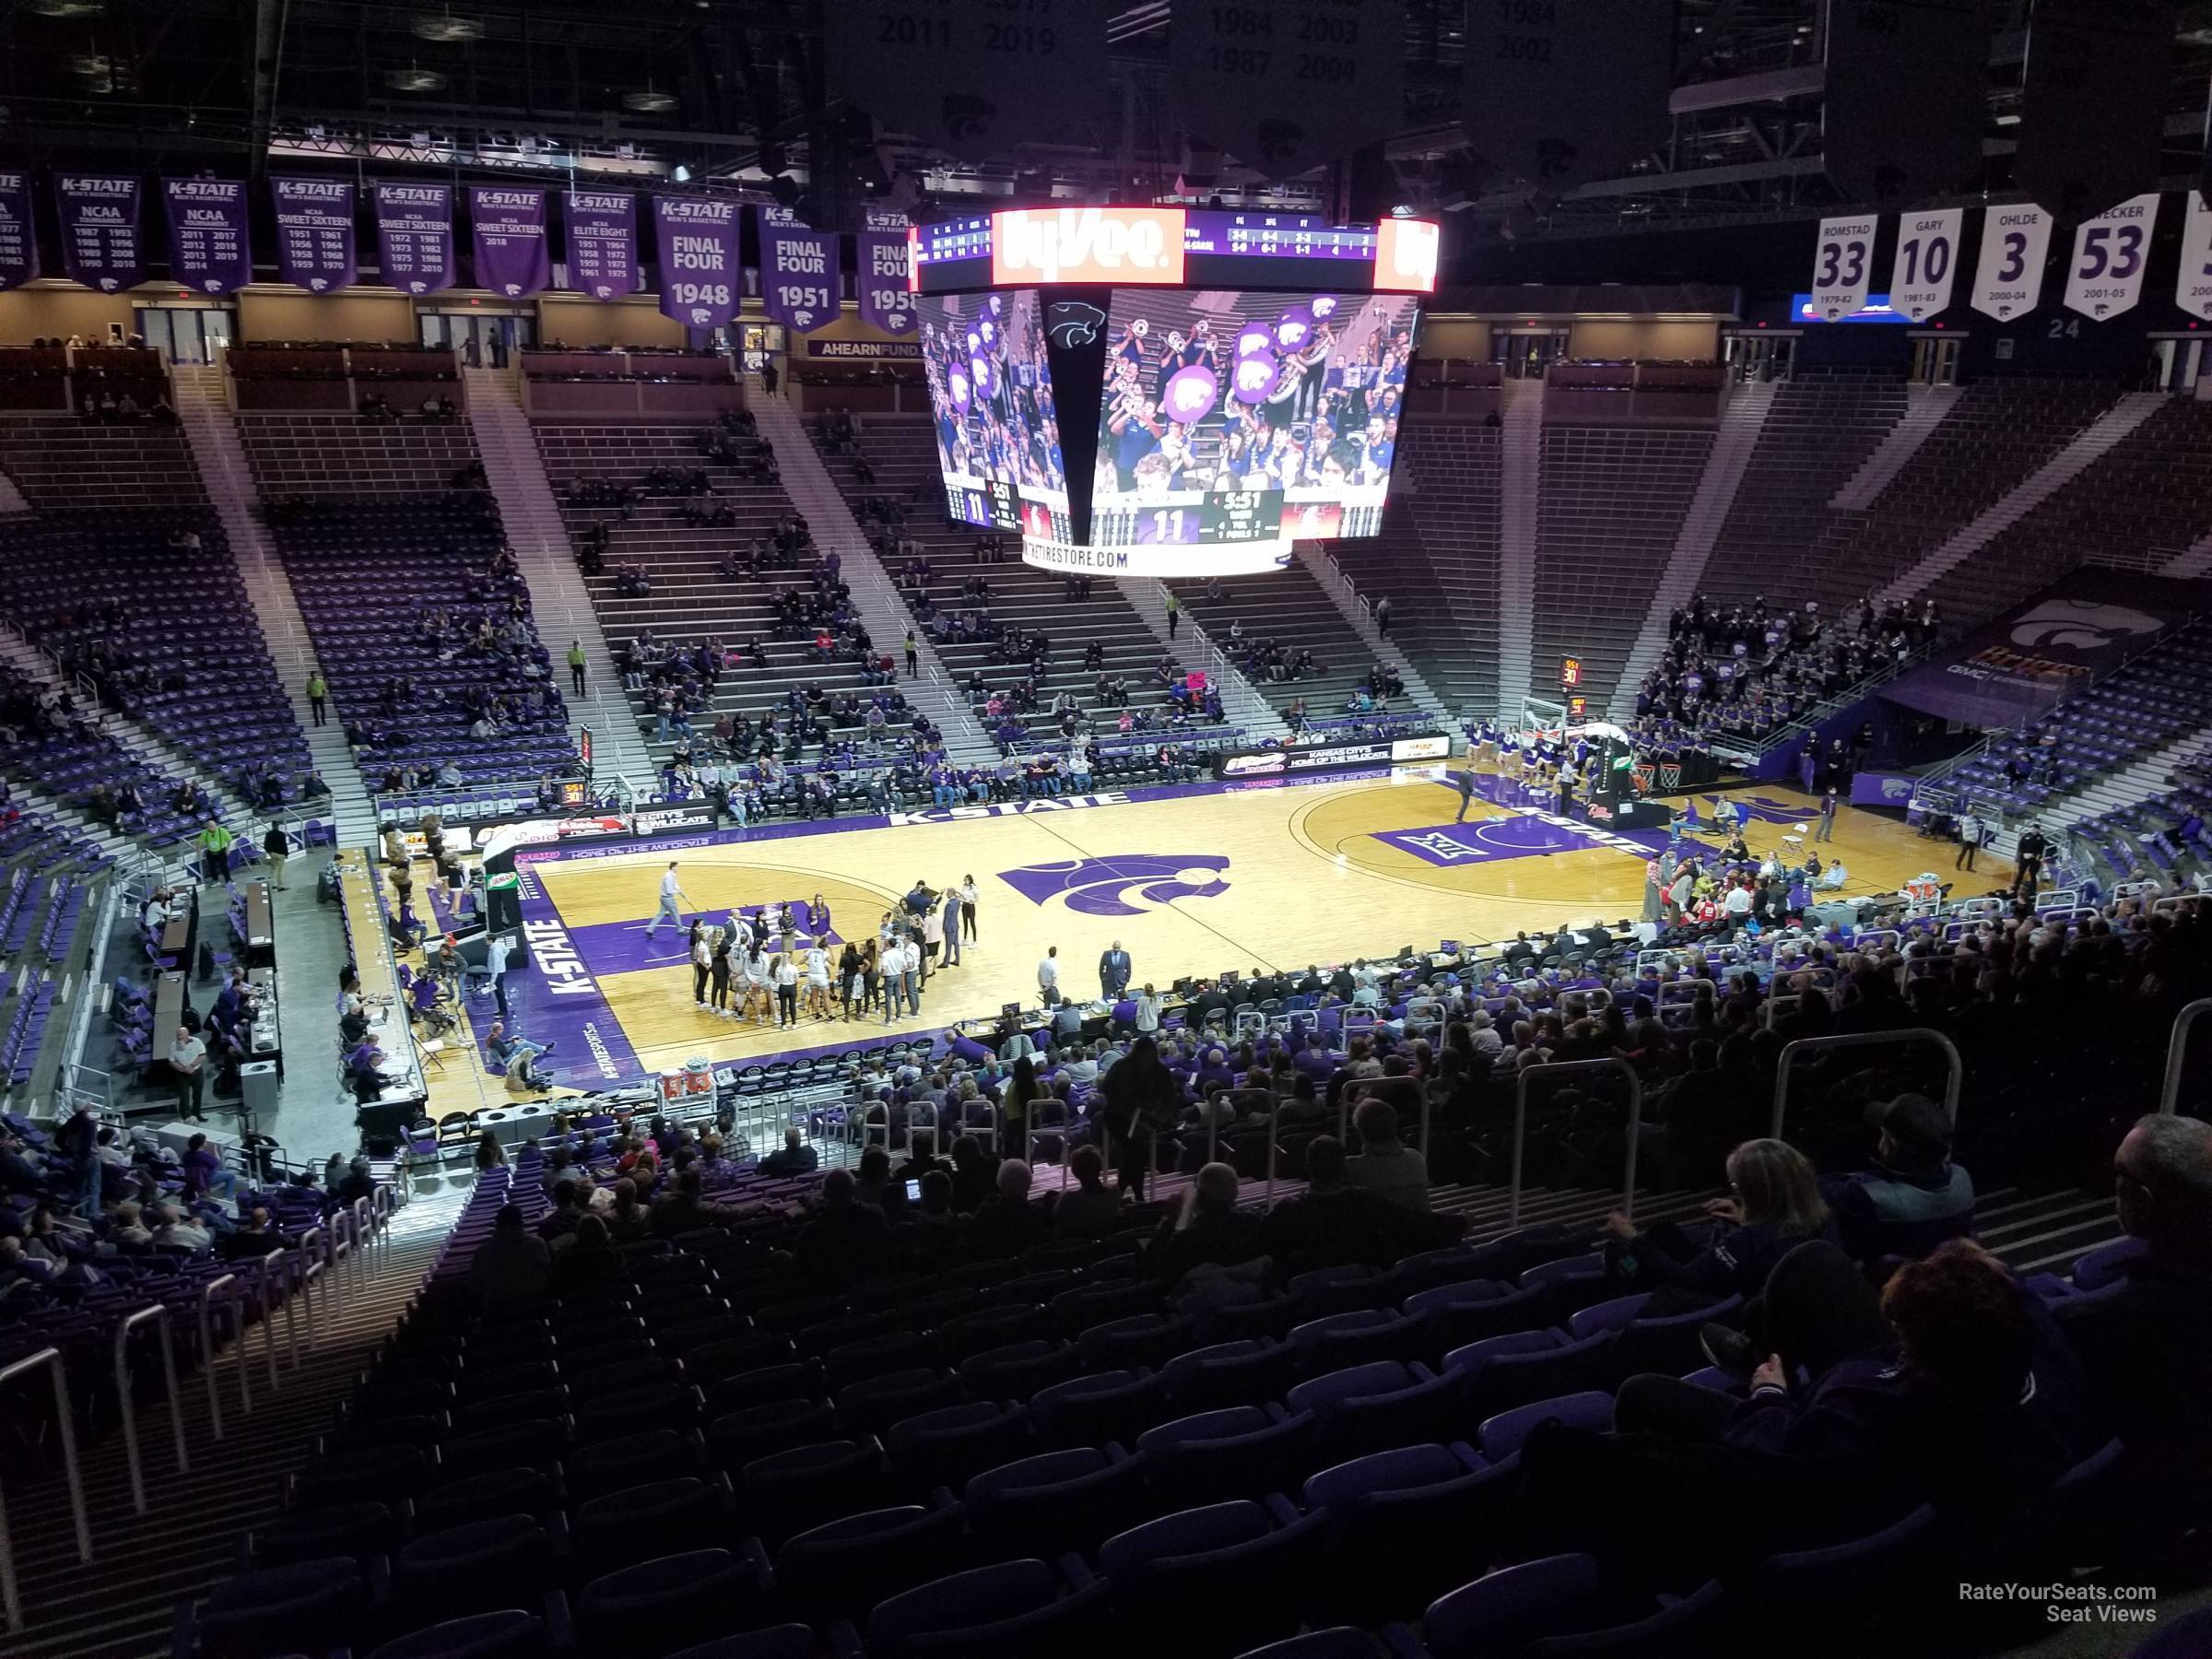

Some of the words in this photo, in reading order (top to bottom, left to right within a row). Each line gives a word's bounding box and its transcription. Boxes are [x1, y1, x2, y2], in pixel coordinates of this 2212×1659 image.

[877, 15, 950, 46] 2011
[986, 22, 1055, 54] 2019
[62, 178, 135, 192] K-STATE
[170, 182, 239, 196] K-STATE
[278, 182, 346, 196] K-STATE
[380, 187, 444, 201] K-STATE
[477, 192, 539, 206] K-STATE
[570, 196, 629, 209] K-STATE
[81, 206, 121, 218] NCAA
[186, 209, 224, 221] NCAA
[661, 202, 734, 219] K-STATE
[277, 214, 312, 225] SWEET
[312, 216, 352, 227] SIXTEEN
[379, 219, 409, 229] SWEET
[411, 219, 450, 230] SIXTEEN
[1915, 219, 1945, 231] GARY
[1999, 214, 2039, 227] OHLDE
[181, 230, 204, 239] 2011
[320, 230, 341, 240] 1961
[476, 223, 507, 232] SWEET
[507, 224, 544, 234] SIXTEEN
[573, 227, 599, 236] ELITE
[599, 227, 628, 238] EIGHT
[1823, 225, 1871, 237] ROMSTAD
[289, 240, 312, 249] 1956
[390, 234, 411, 243] 1972
[486, 238, 507, 246] 2018
[579, 240, 597, 248] 1951
[606, 241, 625, 250] 1964
[673, 236, 724, 254] FINAL
[214, 241, 238, 251] 2018
[391, 244, 412, 253] 1973
[776, 240, 826, 258] FINAL
[2077, 225, 2143, 280] 53
[182, 252, 206, 260] 2013
[579, 250, 599, 258] 1958
[606, 251, 626, 259] 1972
[872, 245, 908, 261] FINA
[1998, 232, 2028, 283] 3
[112, 260, 136, 268] 2010
[291, 260, 314, 269] 1959
[579, 259, 599, 267] 1959
[606, 260, 627, 269] 1973
[673, 253, 724, 271] FOUR
[776, 256, 826, 274] FOUR
[1816, 241, 1866, 288] 33
[1902, 236, 1950, 286] 10
[393, 264, 413, 273] 1977
[420, 265, 442, 273] 2010
[607, 269, 627, 278] 1975
[872, 262, 908, 276] FOU
[671, 283, 730, 306] 1948
[778, 286, 829, 308] 1951
[1819, 295, 1853, 304] 1979-82
[1904, 293, 1936, 303] 1981-83
[1989, 291, 2027, 300] 2000-04
[2084, 288, 2126, 299] 2001-05
[2047, 319, 2081, 338] 24
[822, 343, 919, 357] AHEARNFUND
[968, 492, 984, 522] 11
[1224, 492, 1261, 510] 5:51
[1154, 510, 1183, 542] 11
[1563, 669, 1576, 683] 30
[1947, 665, 1989, 679] GMC
[1290, 757, 1316, 767] HOME
[1316, 756, 1329, 765] OF
[1330, 754, 1345, 763] THE
[1344, 751, 1390, 763] WILDCATS
[1309, 748, 1346, 759] KANSAS
[889, 791, 1132, 826] K-STATE
[648, 815, 710, 828] WILDCATS
[1509, 806, 1659, 855] K-STATE
[523, 919, 596, 994] K-STATE
